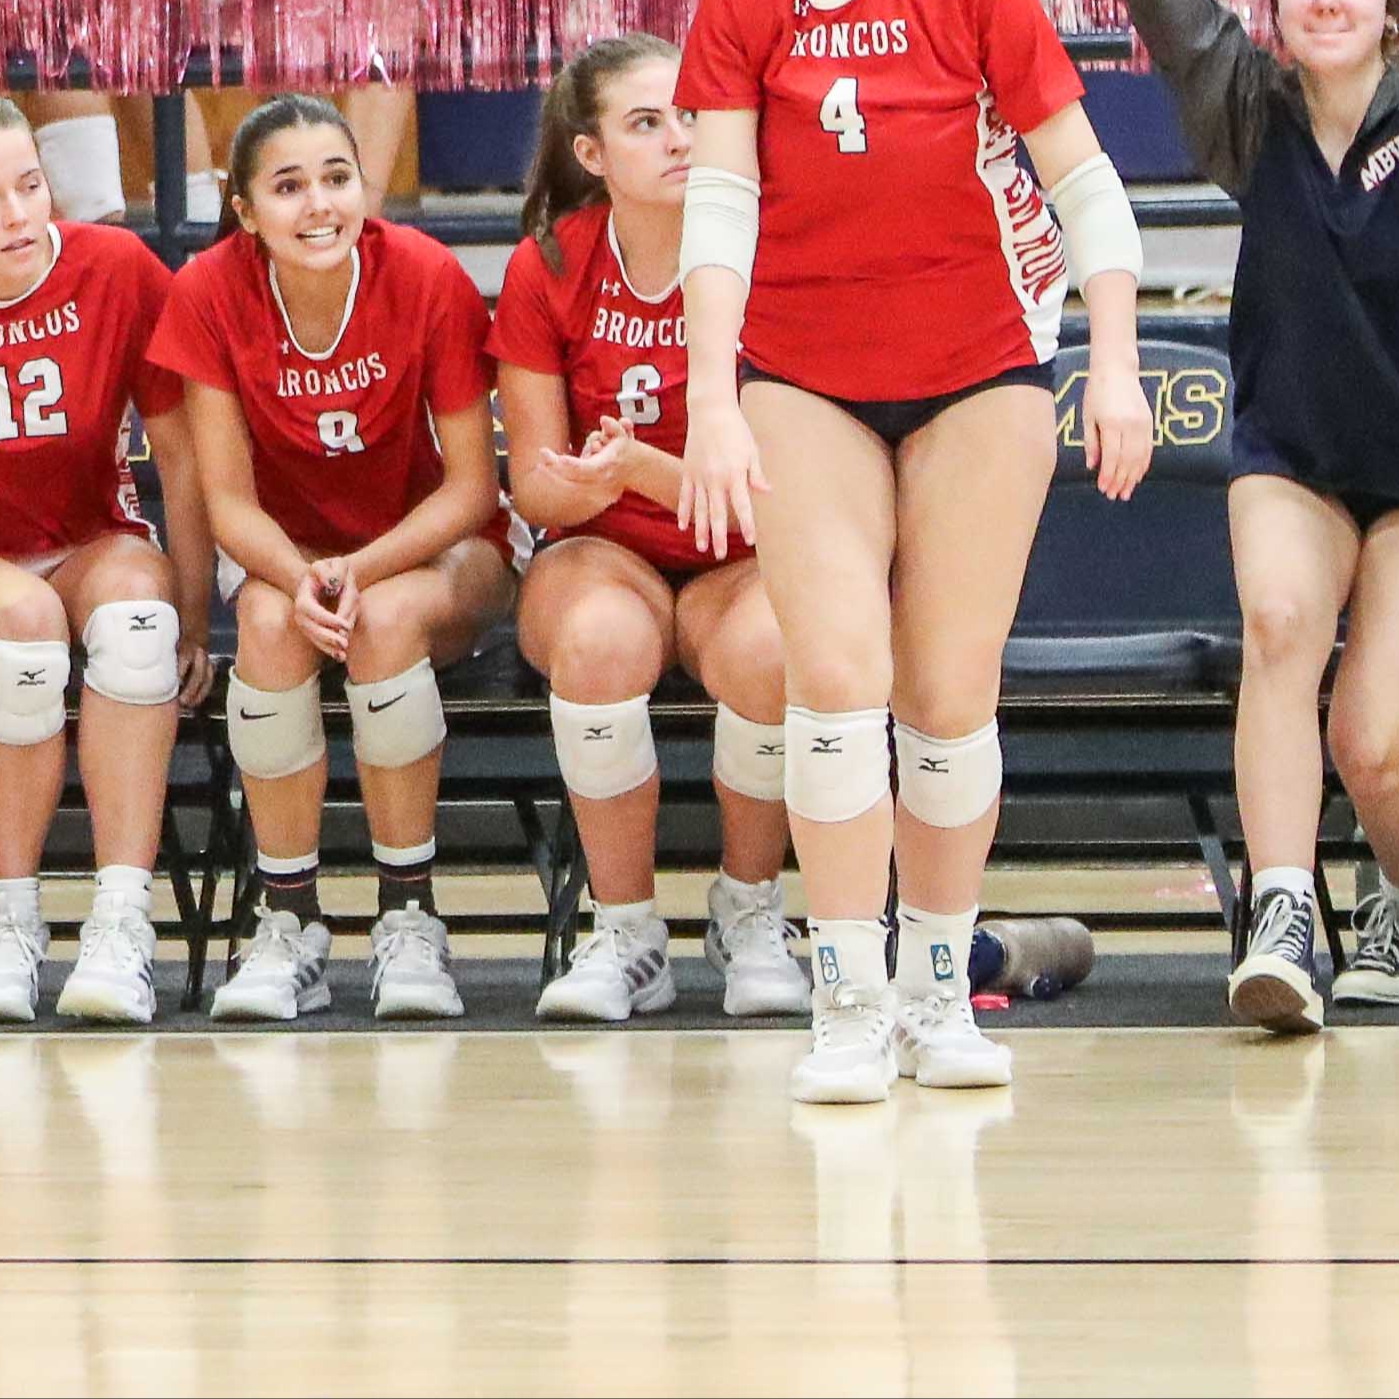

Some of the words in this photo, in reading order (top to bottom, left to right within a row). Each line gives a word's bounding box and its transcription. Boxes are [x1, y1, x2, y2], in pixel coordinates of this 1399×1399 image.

[819, 77, 868, 154] 4
[1011, 220, 1068, 307] RUN
[592, 306, 689, 348] BRONCO
[615, 363, 663, 425] 6
